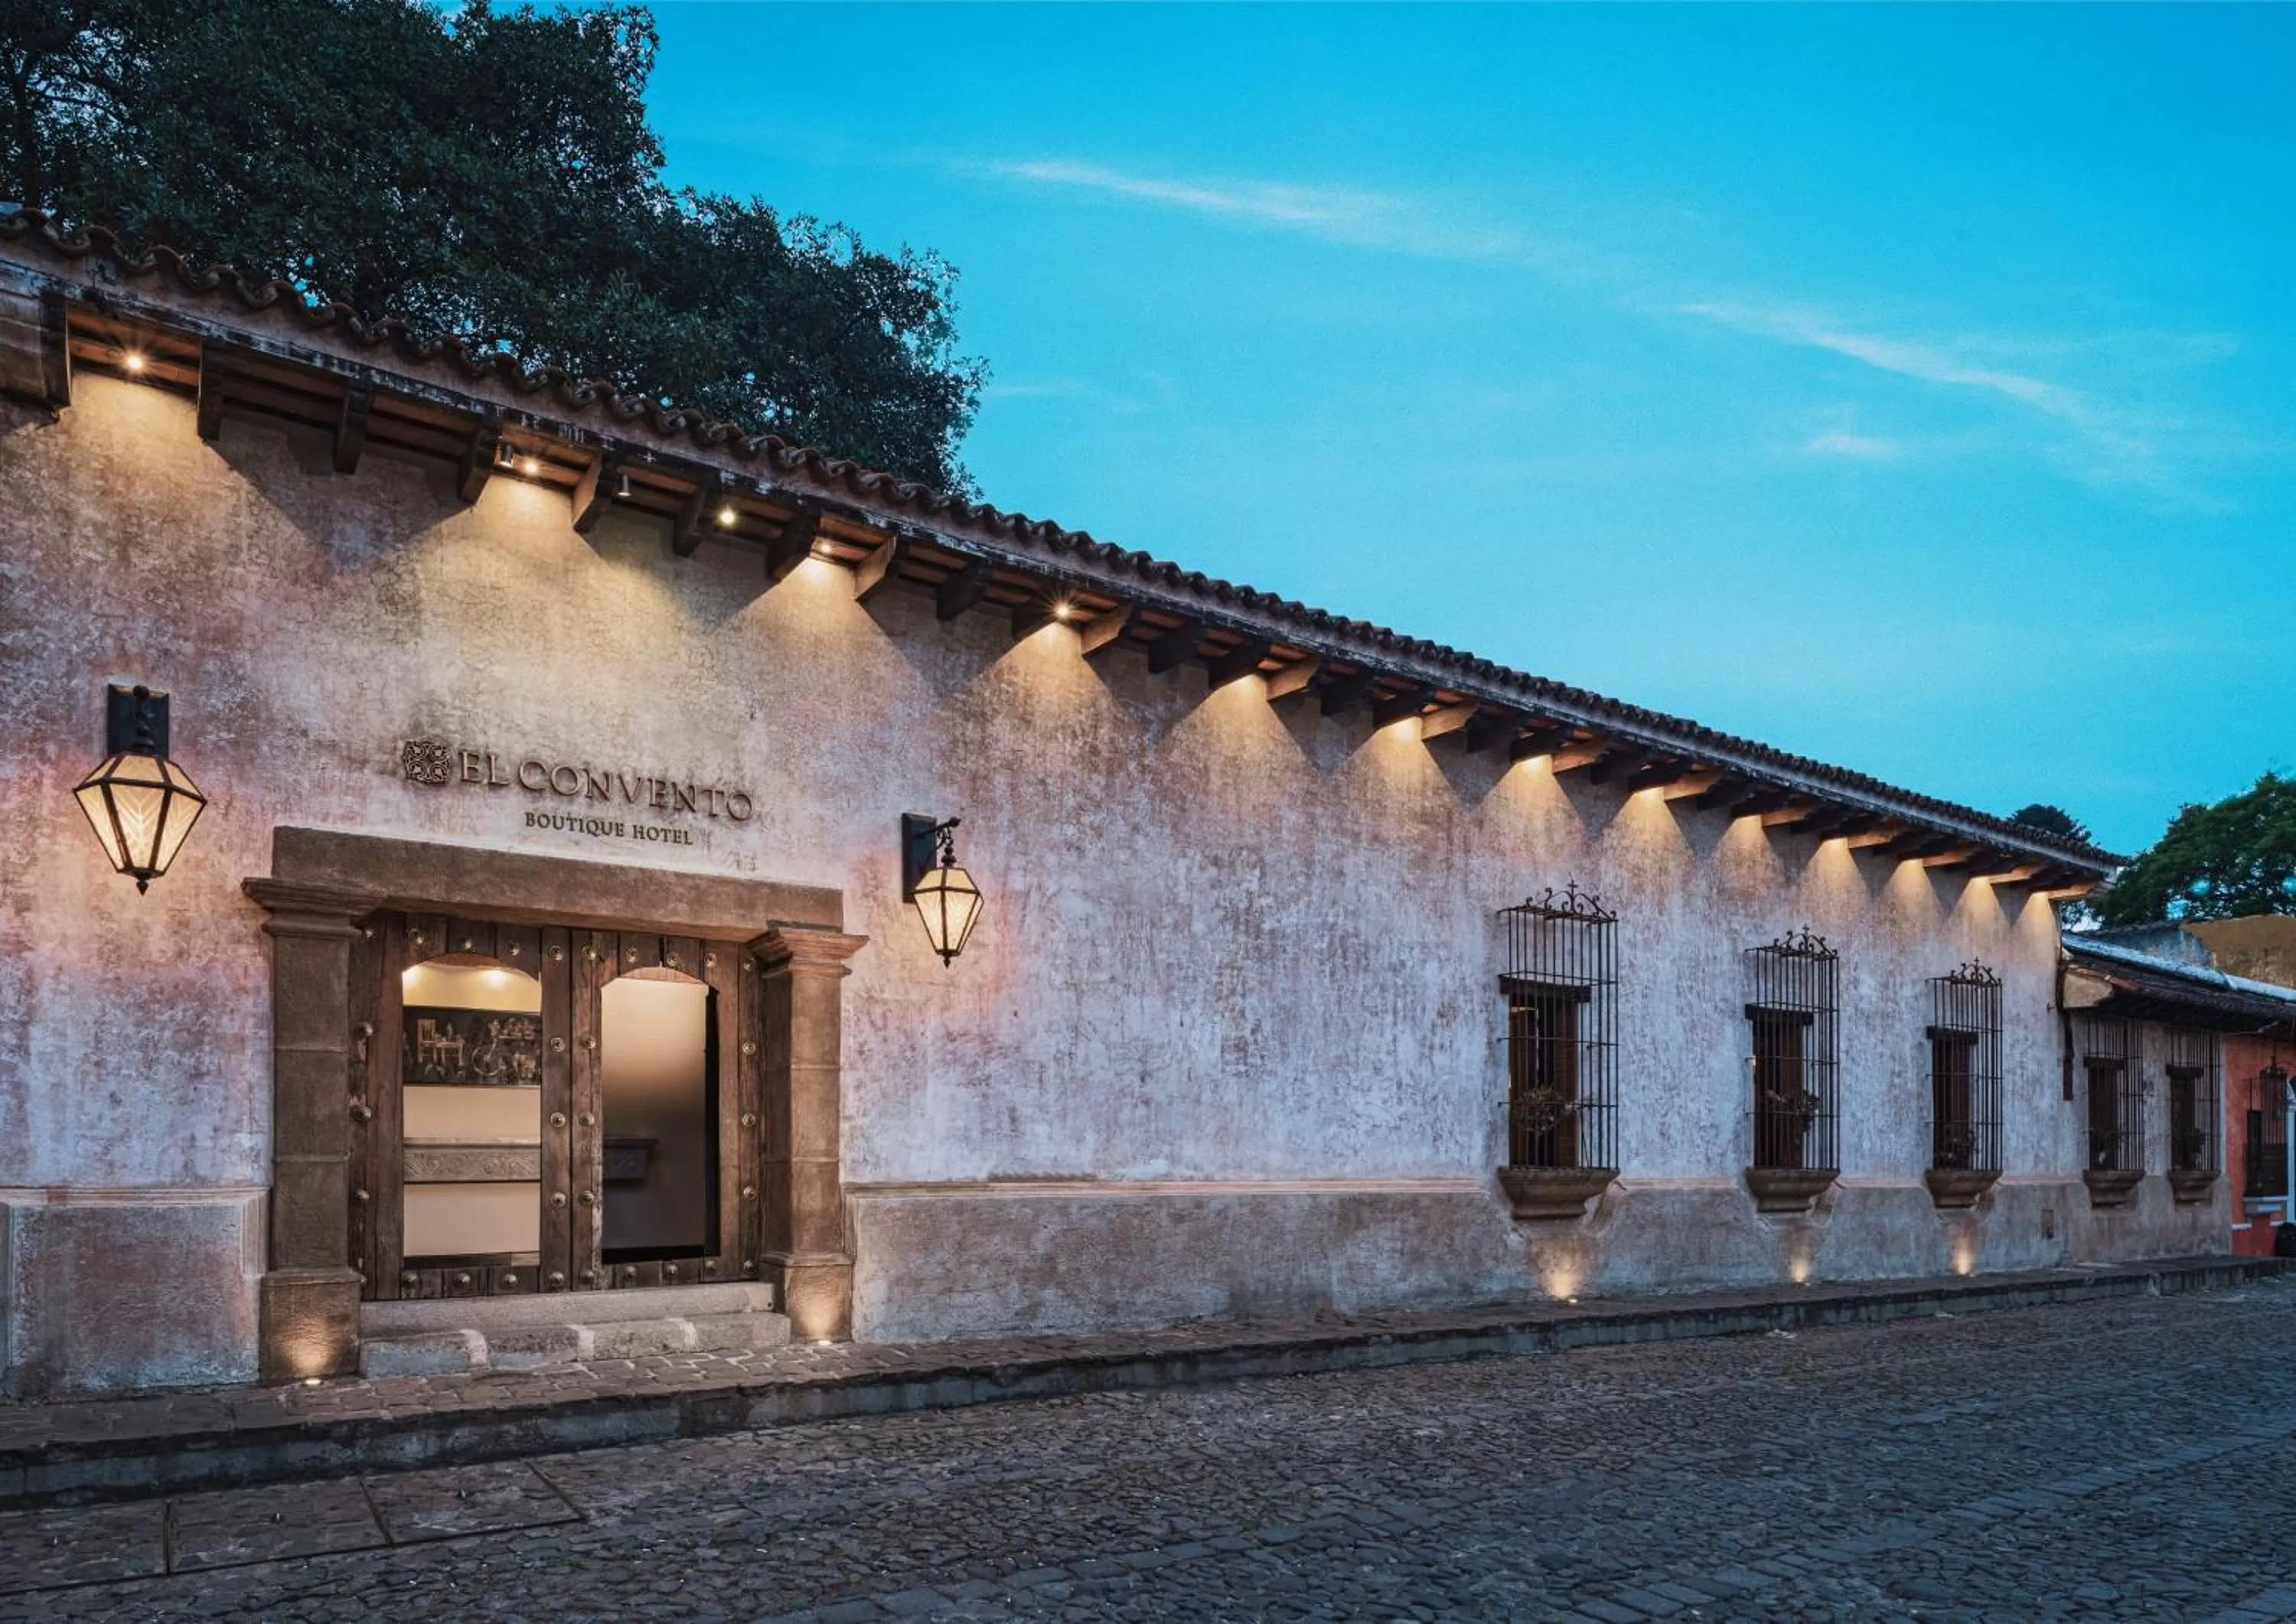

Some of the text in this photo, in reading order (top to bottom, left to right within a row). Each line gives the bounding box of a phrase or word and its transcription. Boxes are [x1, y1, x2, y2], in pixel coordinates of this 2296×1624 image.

[459, 749, 753, 820] EL CONVENTO
[525, 811, 693, 845] BOUTIQUE HOTEL
